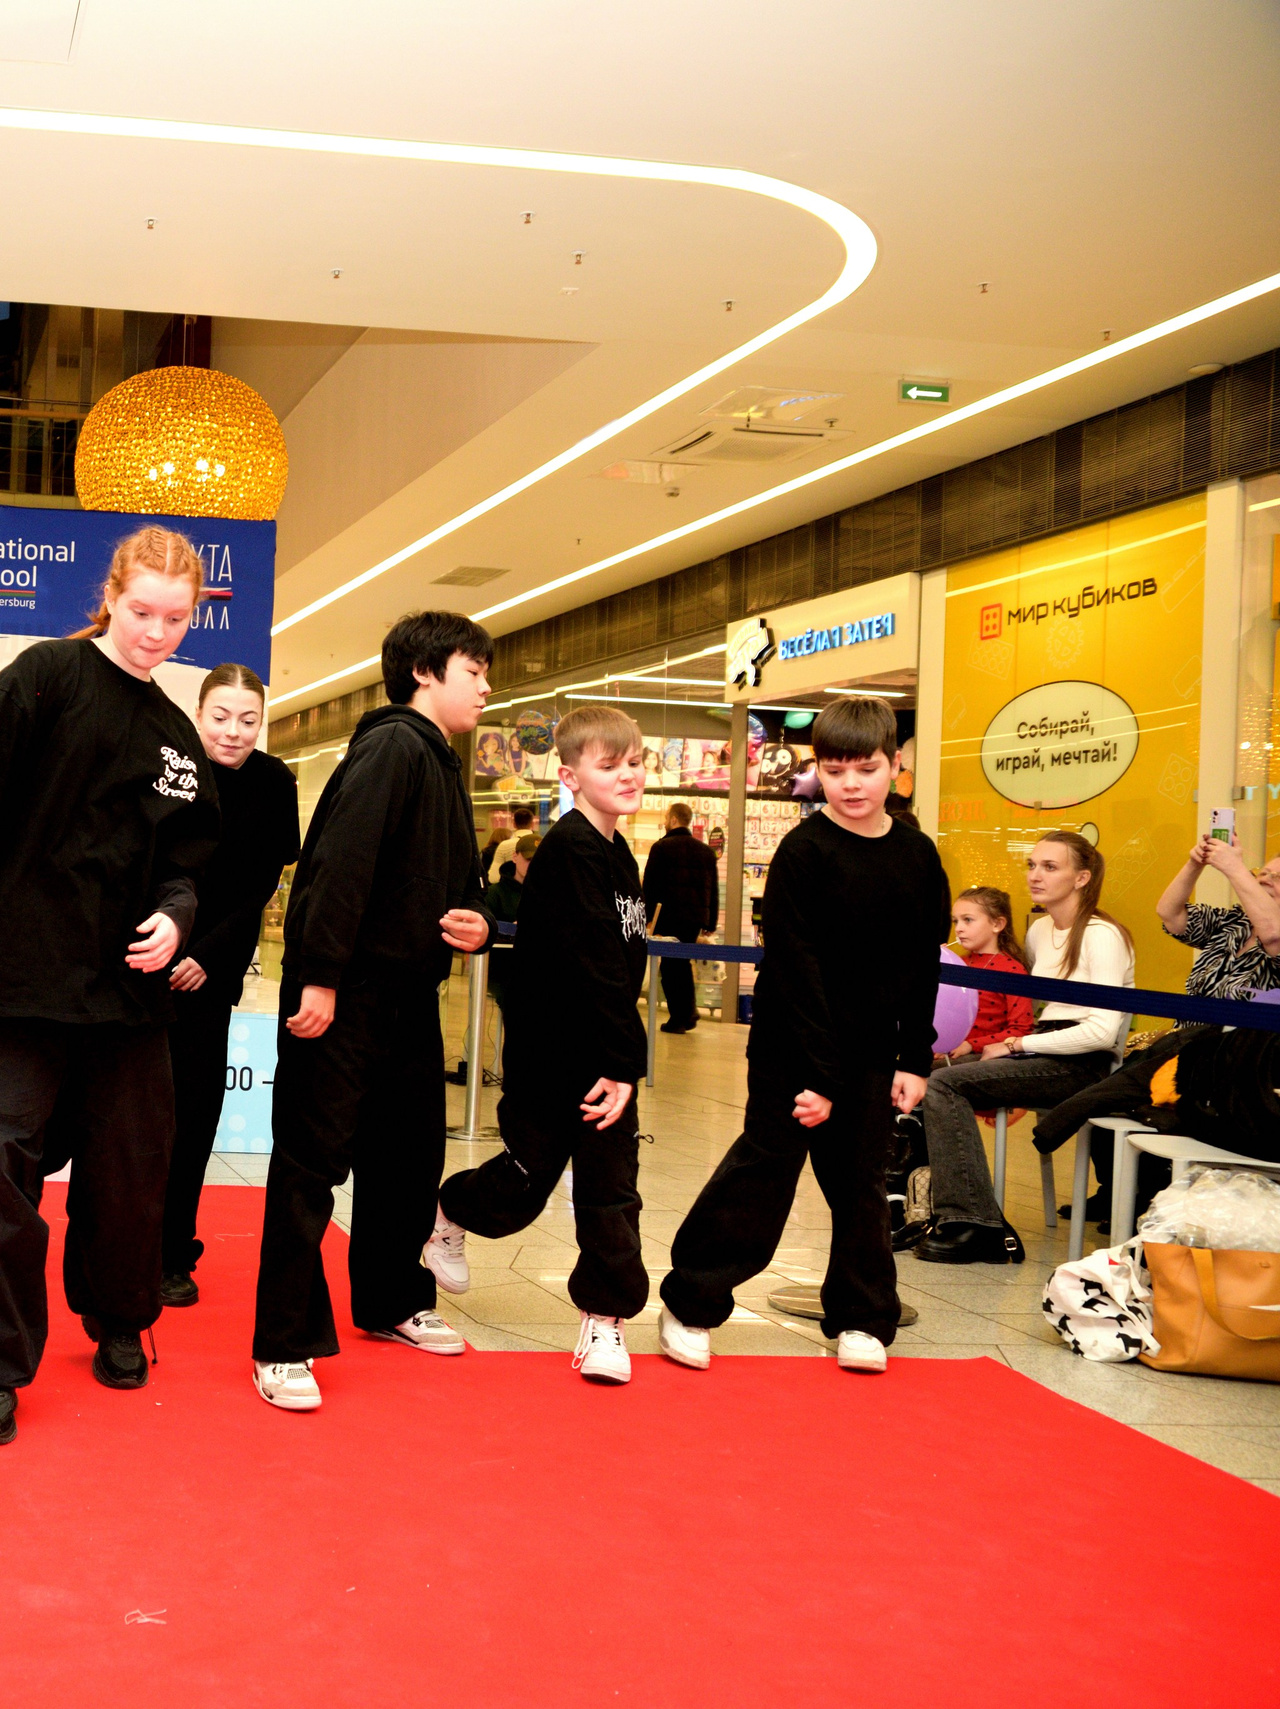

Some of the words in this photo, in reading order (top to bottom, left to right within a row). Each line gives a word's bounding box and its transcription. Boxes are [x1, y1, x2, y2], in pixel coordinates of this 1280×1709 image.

[778, 628, 841, 660] ВЕСЁЛАЯ
[842, 612, 895, 646] ЗАТЕЯ
[1016, 711, 1095, 739] Собирай,
[996, 747, 1045, 774] играй,
[1050, 741, 1118, 767] мечтай!
[164, 764, 179, 783] by
